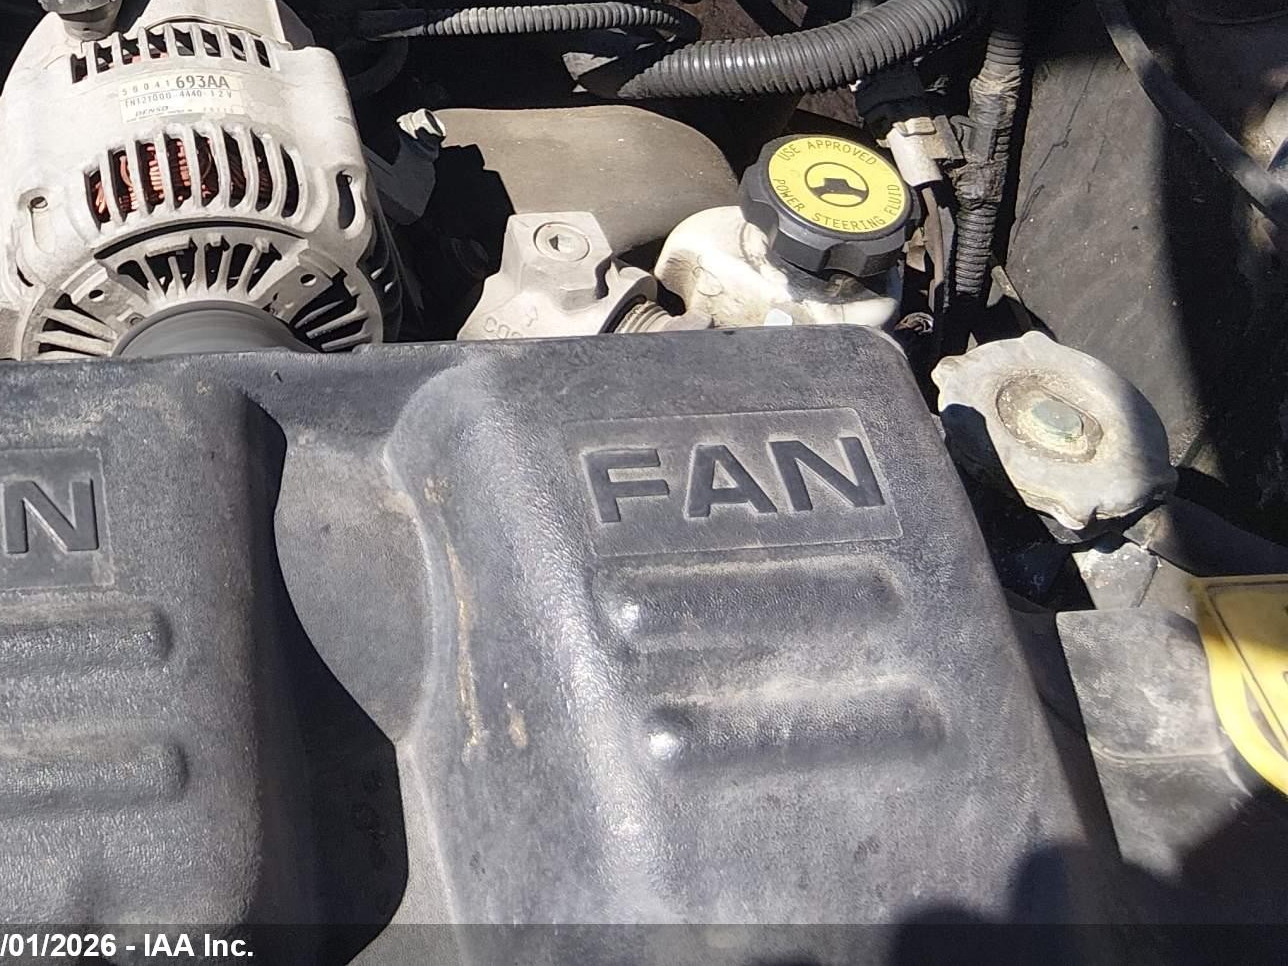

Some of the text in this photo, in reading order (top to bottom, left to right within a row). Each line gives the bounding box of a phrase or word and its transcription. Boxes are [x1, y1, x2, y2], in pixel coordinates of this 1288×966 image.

[175, 75, 231, 89] 693AA
[778, 139, 877, 166] USE APPROVED
[773, 178, 902, 232] POWER STEERING FLUID
[580, 435, 886, 523] FAN
